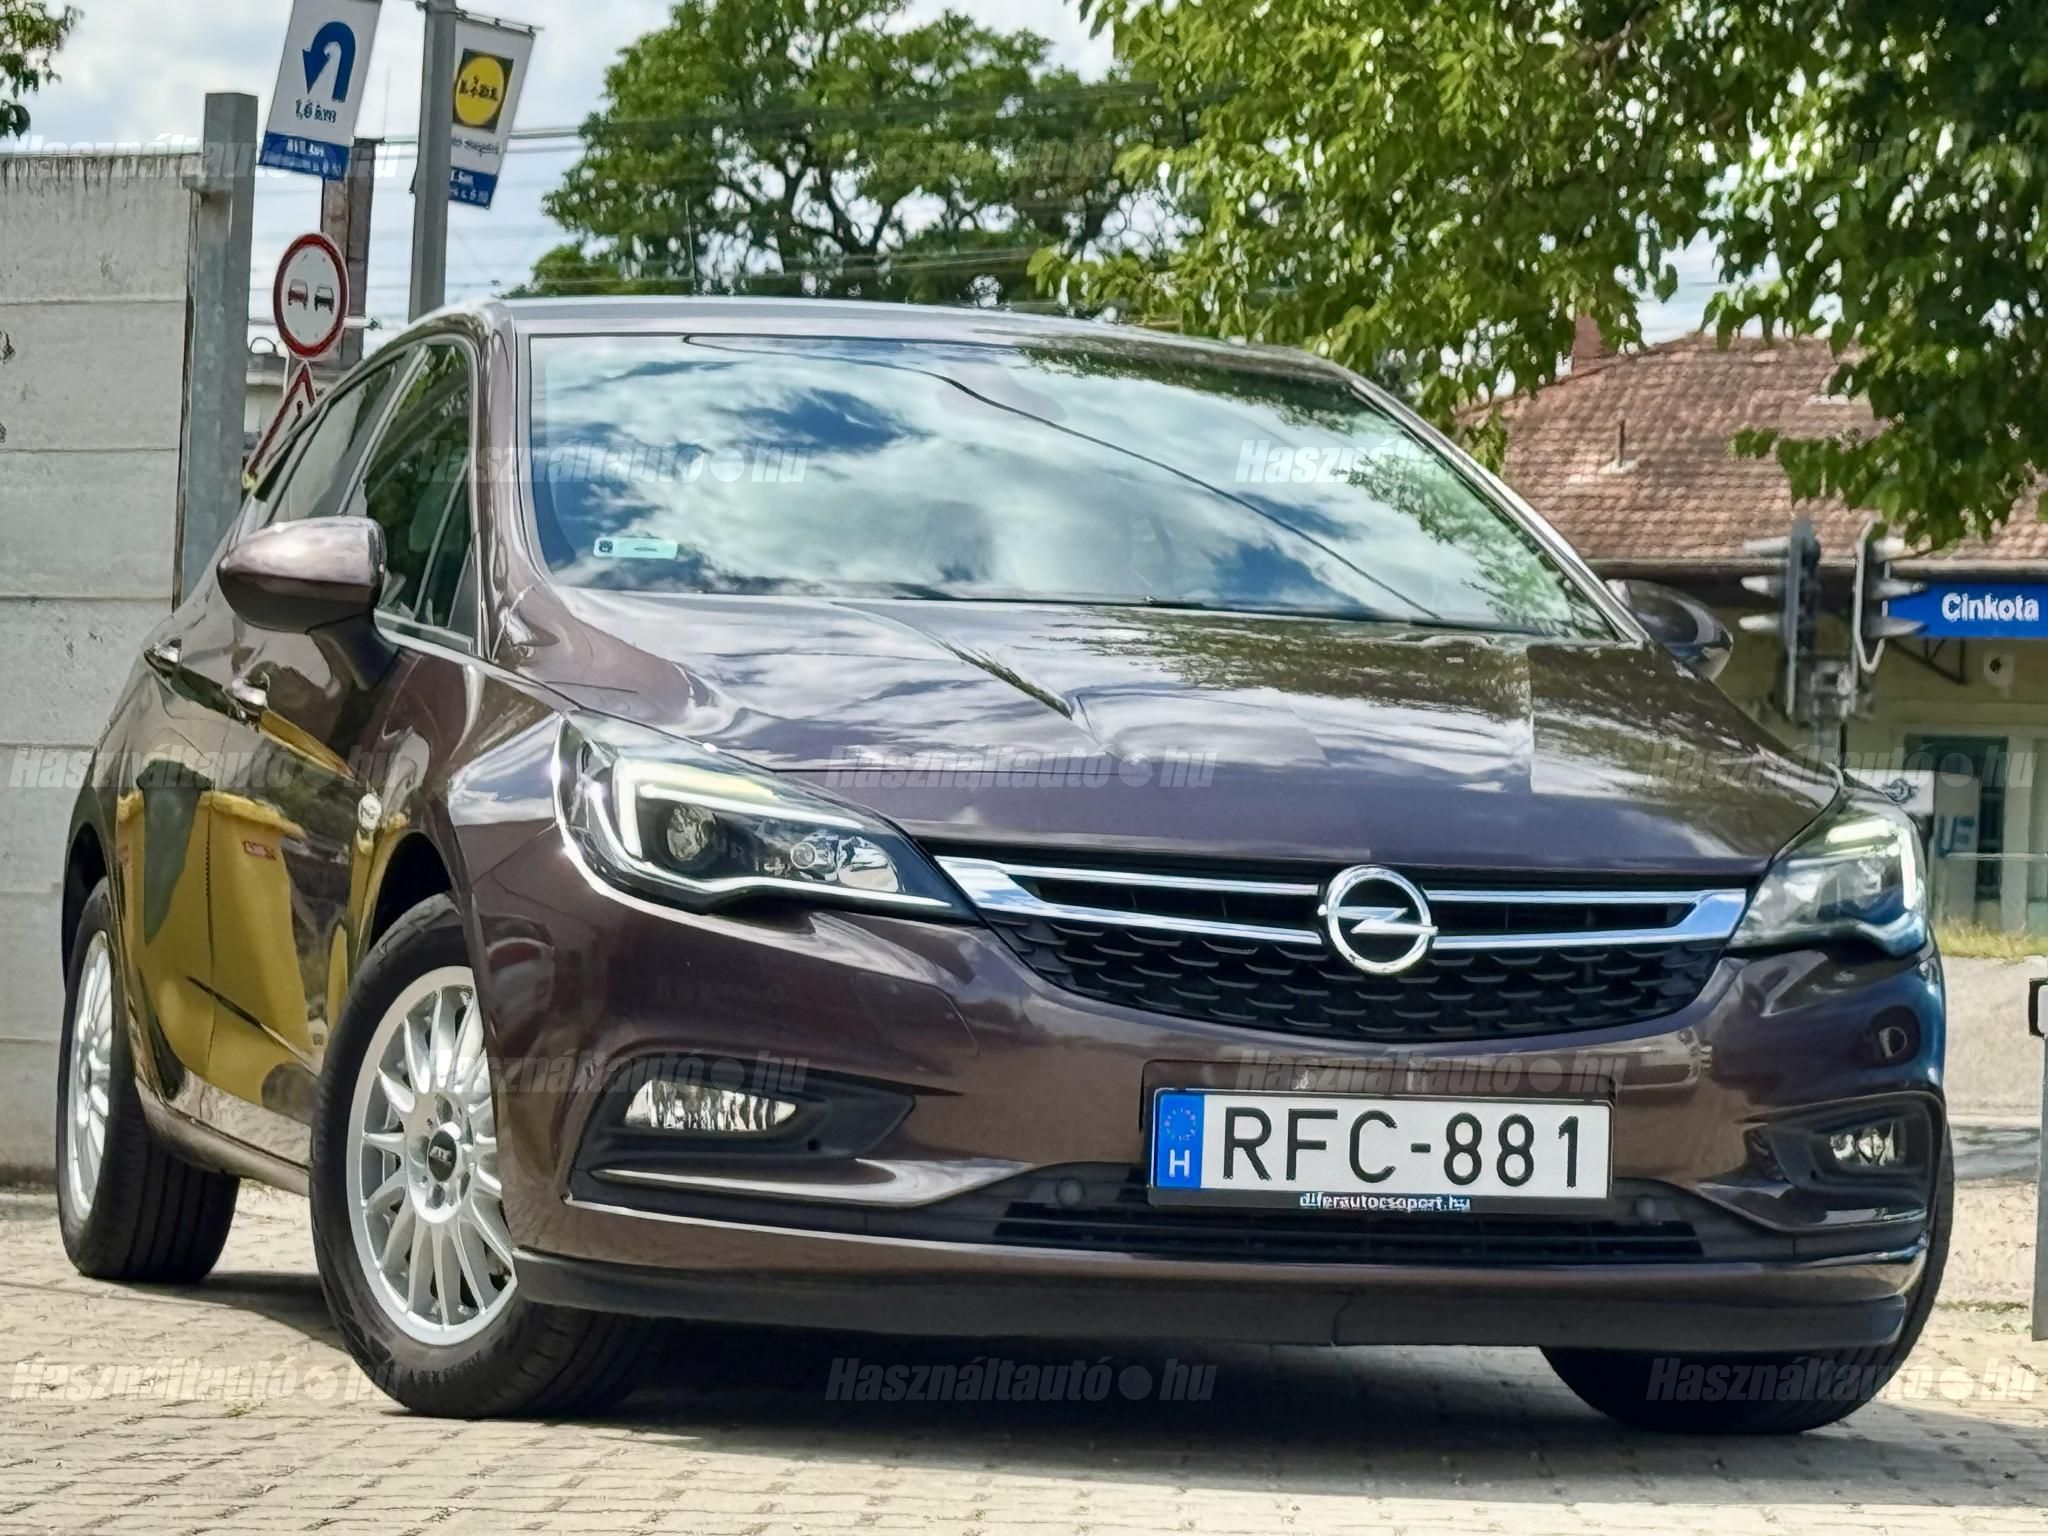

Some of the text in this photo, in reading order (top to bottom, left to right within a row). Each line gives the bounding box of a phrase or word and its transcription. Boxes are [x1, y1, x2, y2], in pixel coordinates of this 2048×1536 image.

[1941, 592, 2039, 622] Cinkota
[1168, 1106, 1579, 1189] H RFC-881
